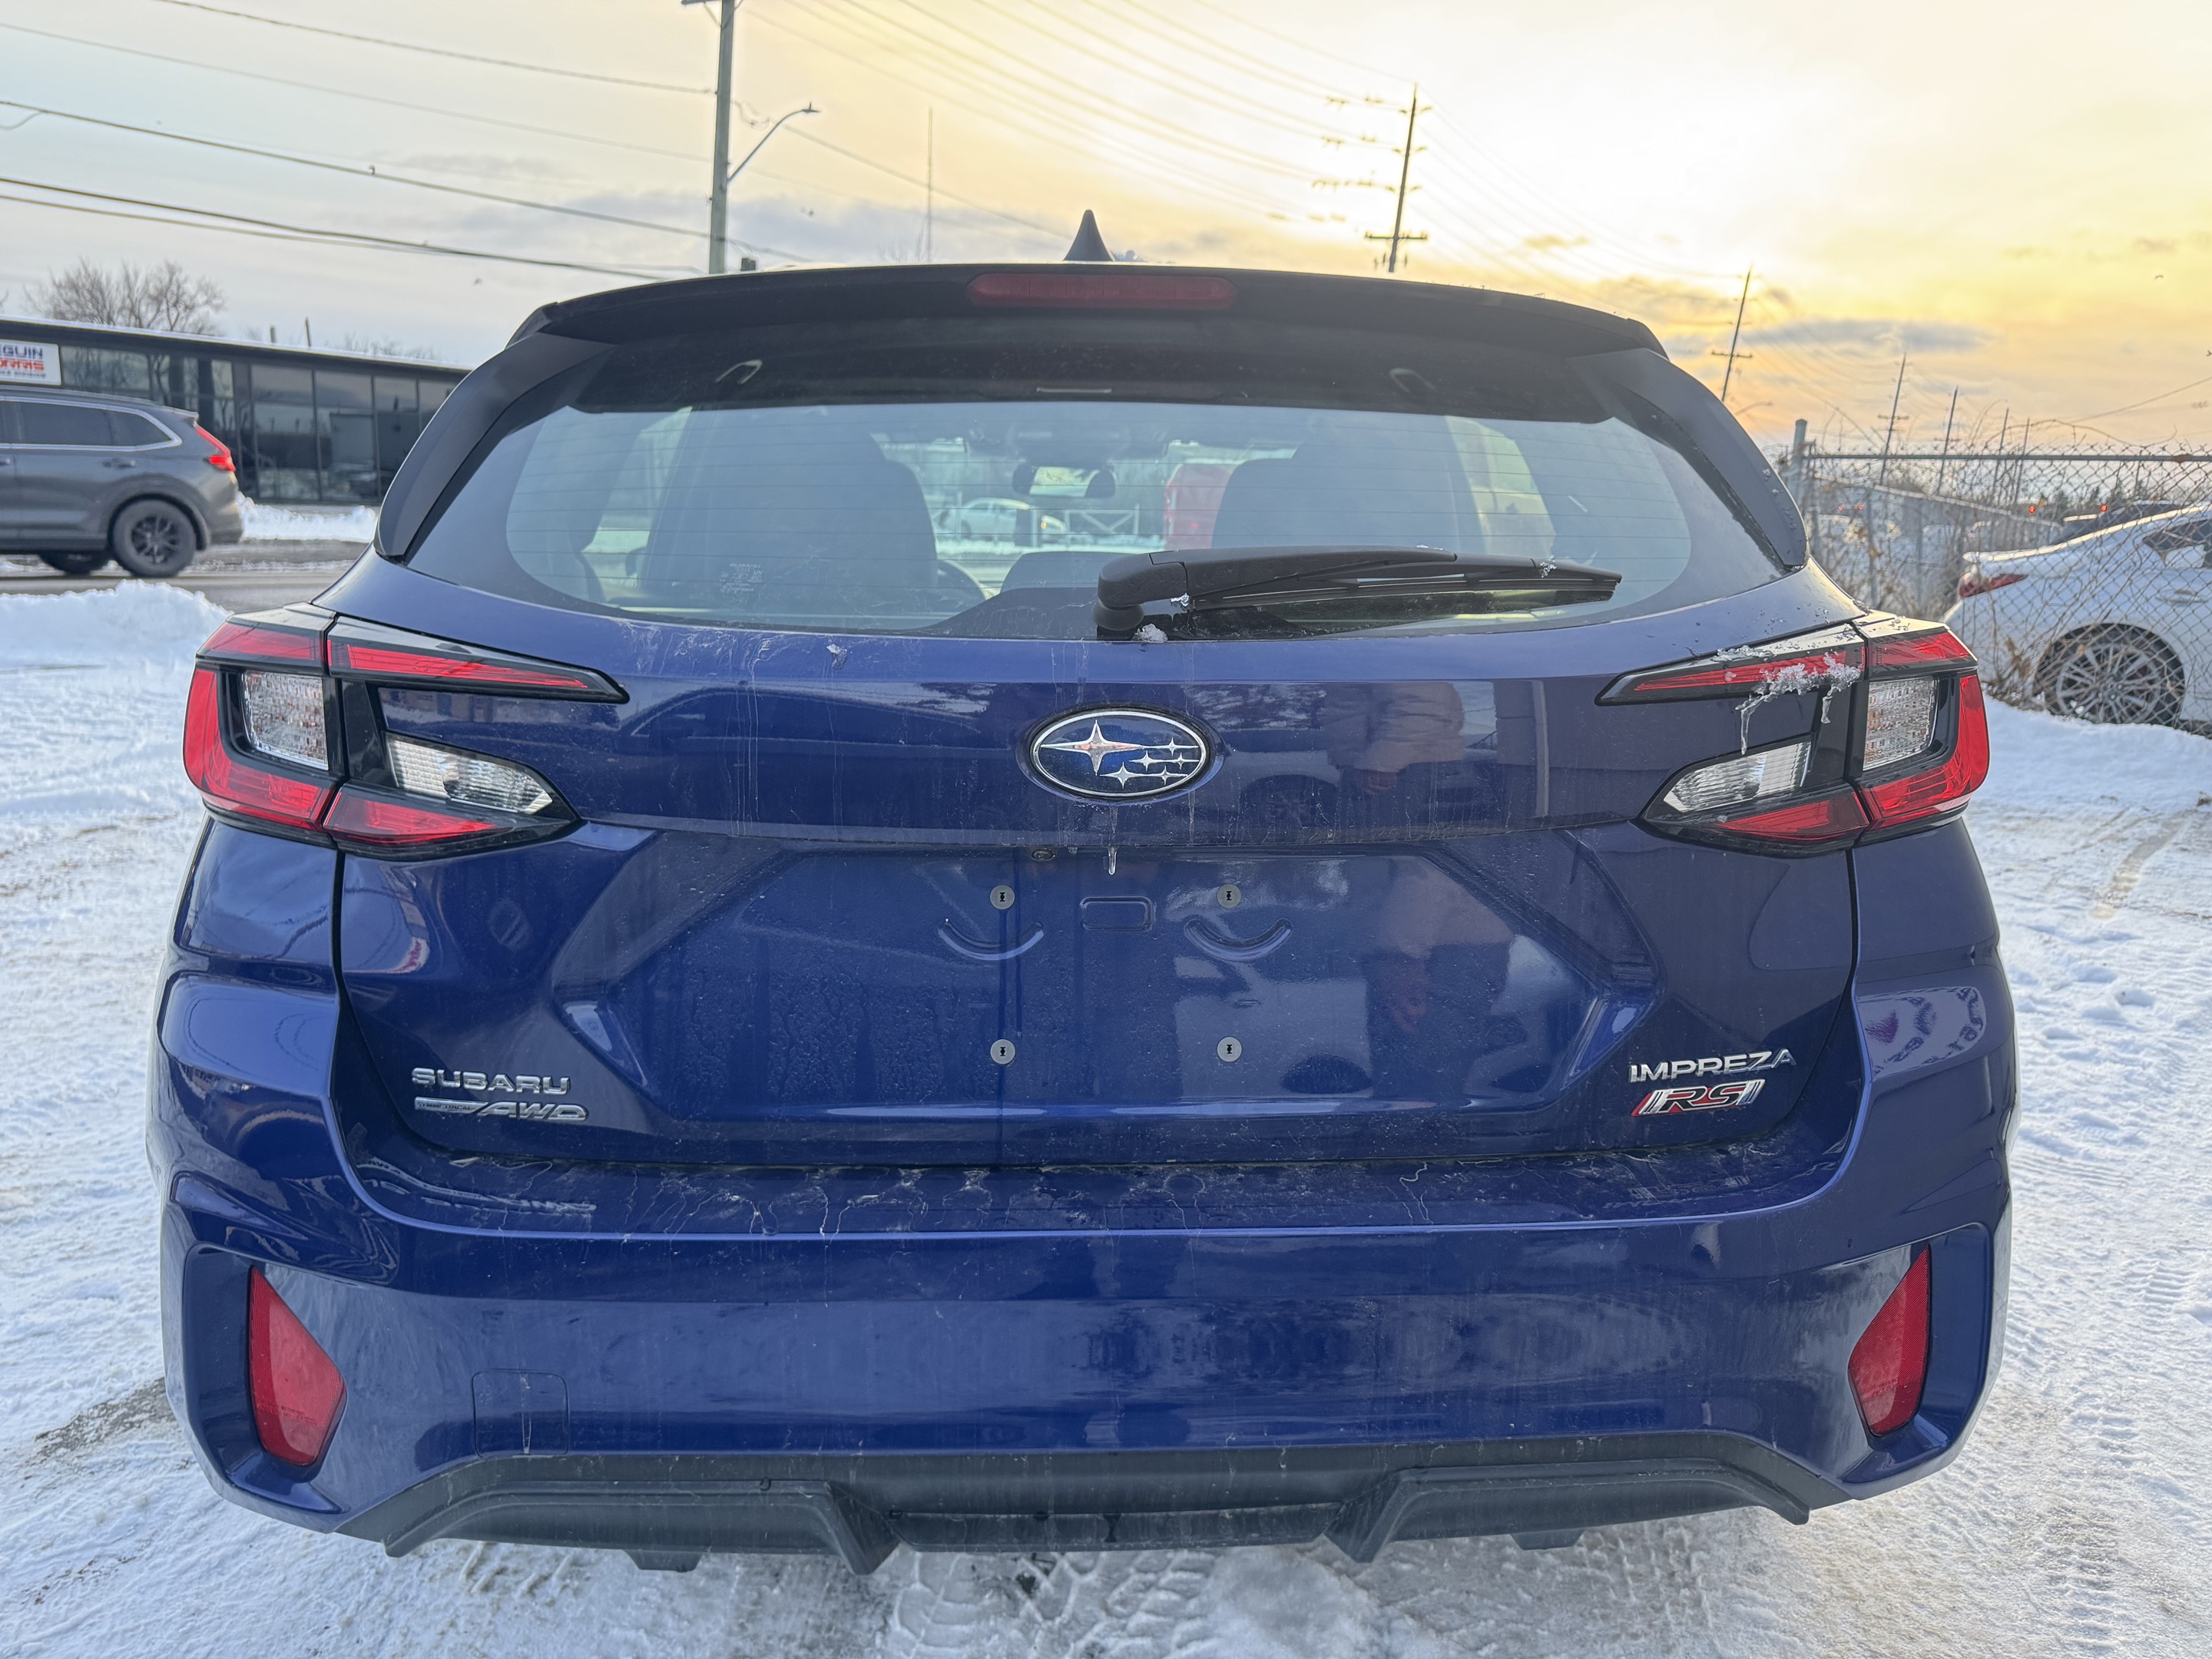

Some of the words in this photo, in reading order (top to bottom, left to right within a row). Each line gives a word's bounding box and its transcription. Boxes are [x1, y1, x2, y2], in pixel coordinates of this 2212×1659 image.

[0, 344, 42, 359] GUIN
[1629, 1048, 1796, 1083] IMPREZA
[412, 1067, 570, 1095] SUBARU
[477, 1101, 588, 1121] AWD
[1654, 1081, 1749, 1114] RS
